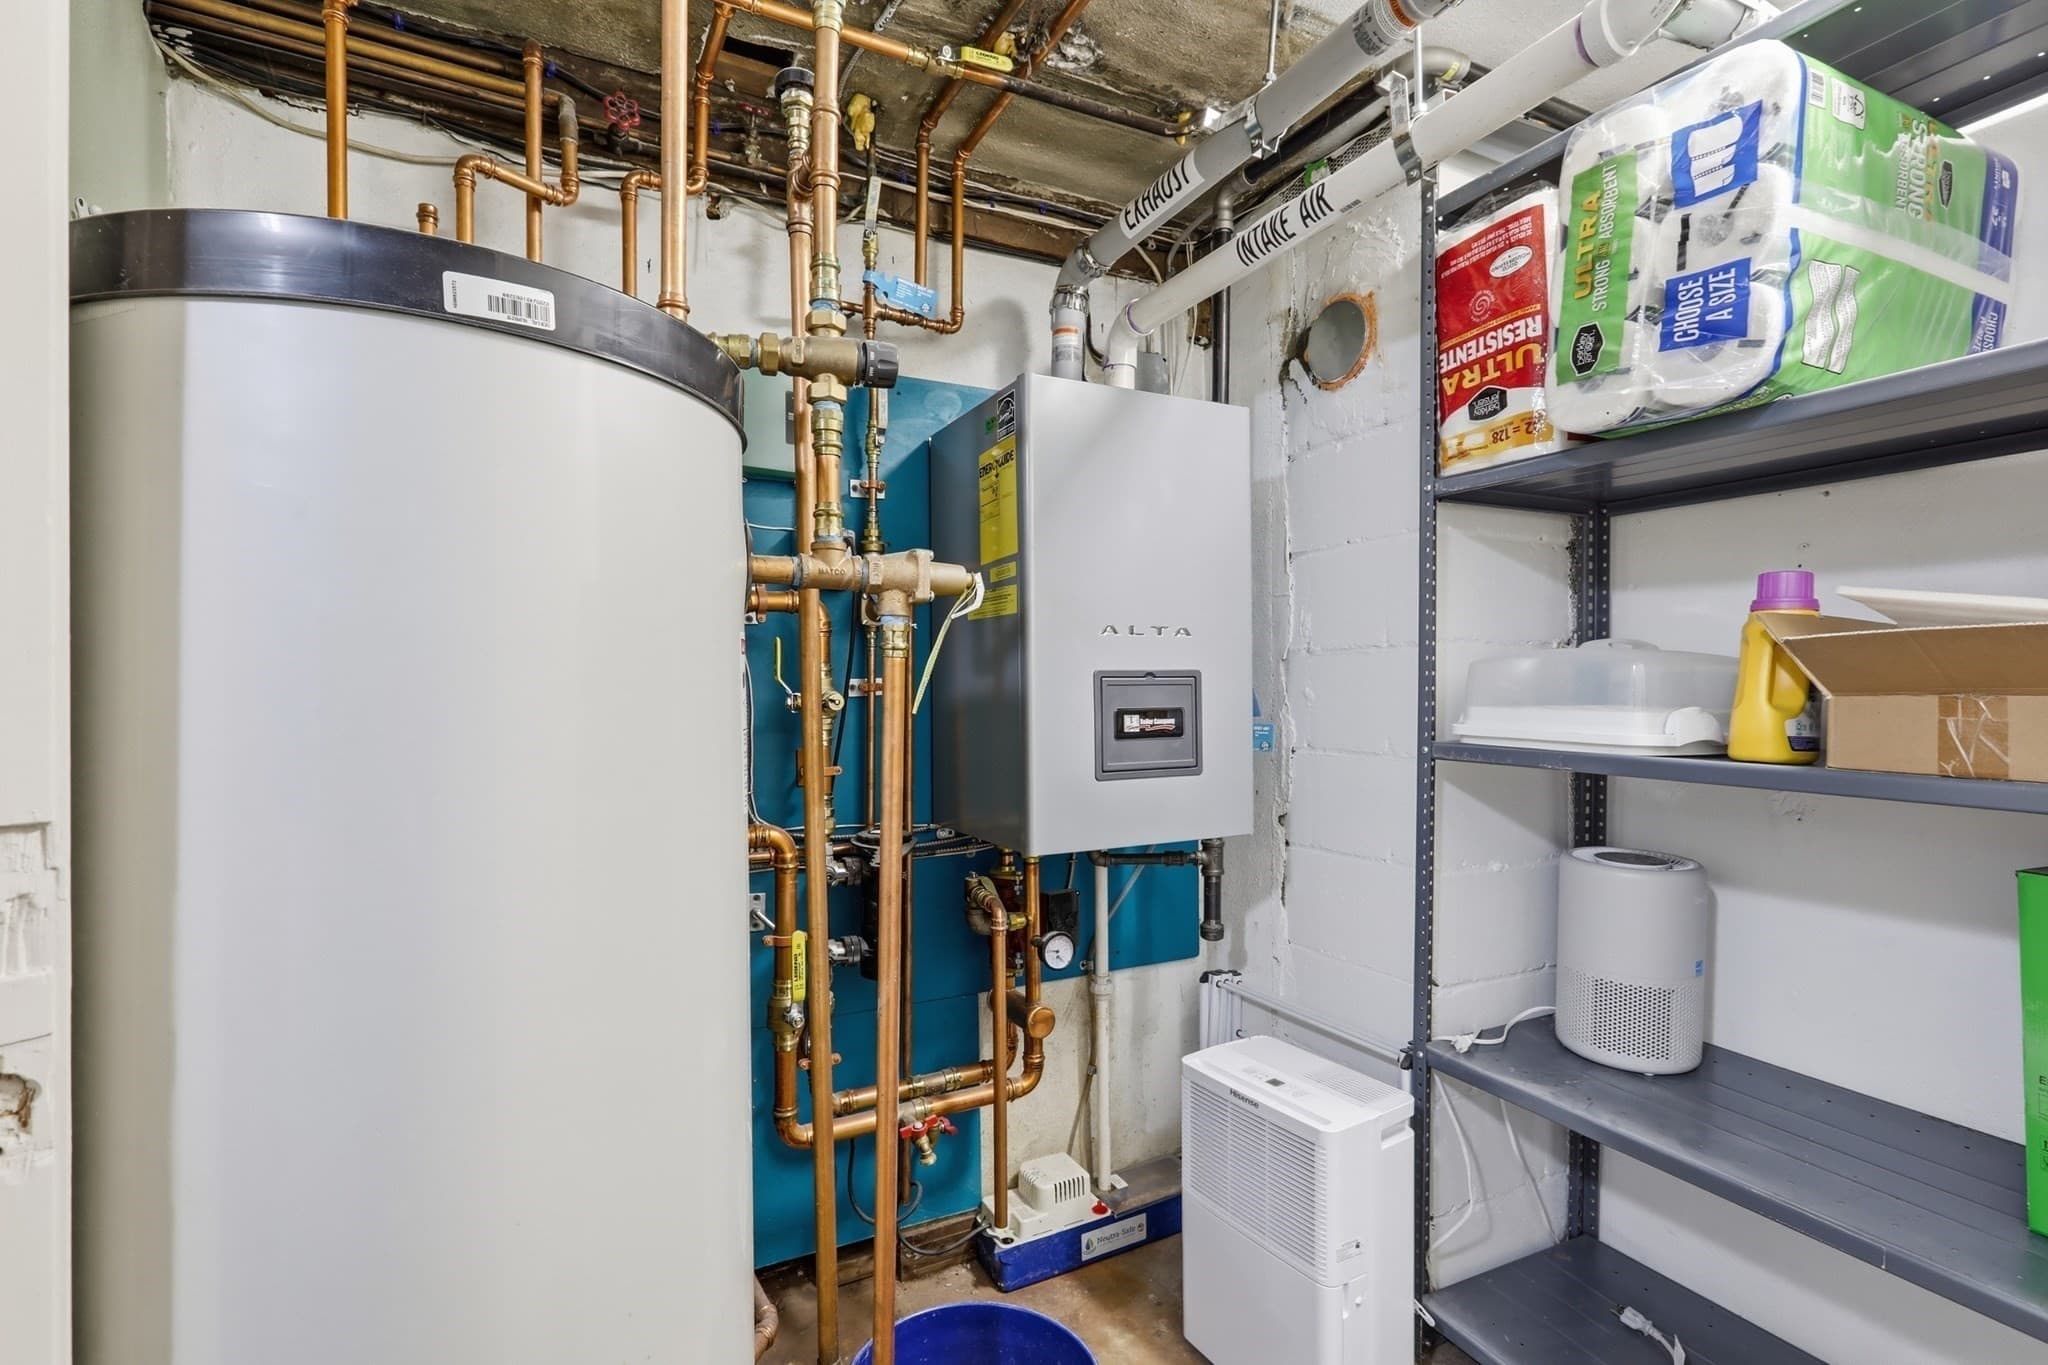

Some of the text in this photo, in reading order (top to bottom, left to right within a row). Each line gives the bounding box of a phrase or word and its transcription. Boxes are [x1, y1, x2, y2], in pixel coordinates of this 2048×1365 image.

[1124, 160, 1192, 231] EXHAUST
[1598, 162, 1617, 241] ABSORBENT
[1236, 207, 1299, 267] INTAKE
[1298, 182, 1335, 230] AIR
[1573, 190, 1602, 300] ULTRA
[1591, 259, 1612, 313] STRONG
[1674, 276, 1705, 344] CHOOSE
[1705, 267, 1737, 322] A SIZE
[1439, 315, 1543, 374] RESISTENTE
[1441, 343, 1544, 396] ULTRA
[1576, 331, 1587, 367] berkley
[1491, 426, 1512, 445] 128
[1098, 624, 1193, 639] ALTA
[1229, 1087, 1260, 1110] Hisense
